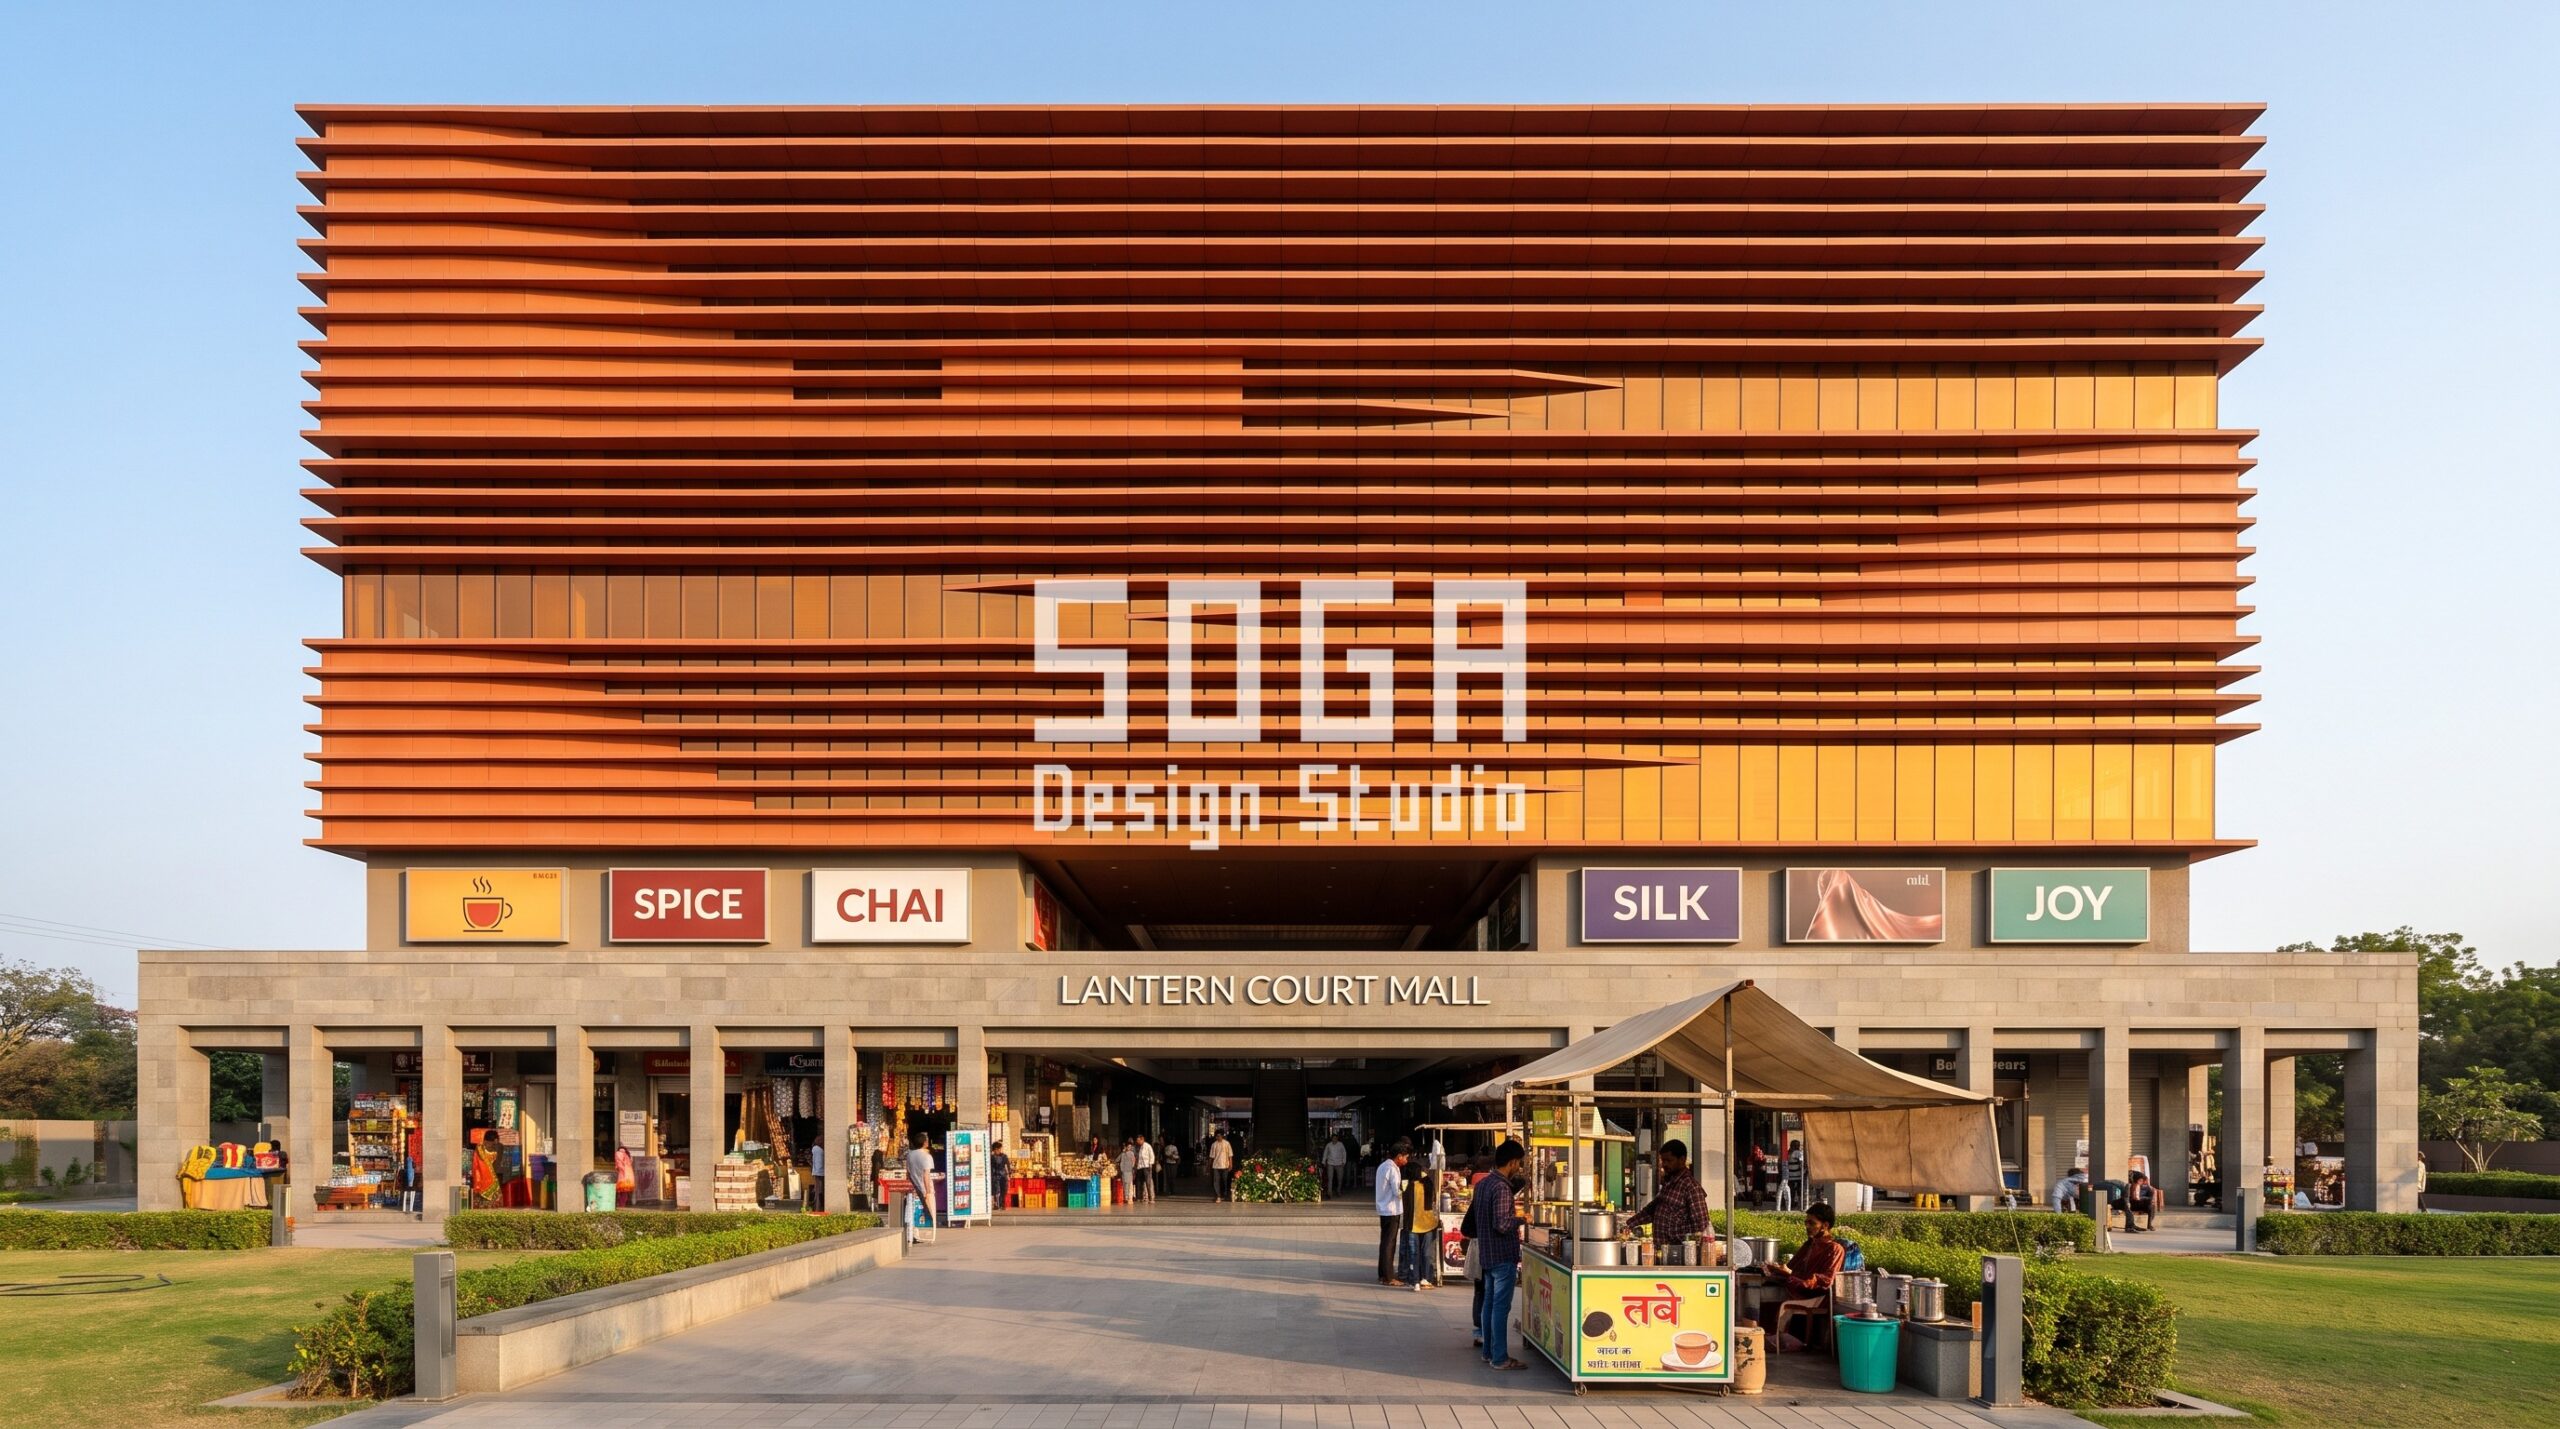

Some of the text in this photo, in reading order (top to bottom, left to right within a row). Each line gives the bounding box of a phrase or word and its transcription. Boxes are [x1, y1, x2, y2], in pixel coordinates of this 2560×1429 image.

[633, 888, 743, 920] SPICE
[836, 888, 944, 922] CHAI
[1613, 885, 1710, 921] SILK
[2026, 885, 2113, 922] JOY
[1061, 974, 1491, 1006] LANTERN COURT MALL
[1993, 1060, 2026, 1070] ears
